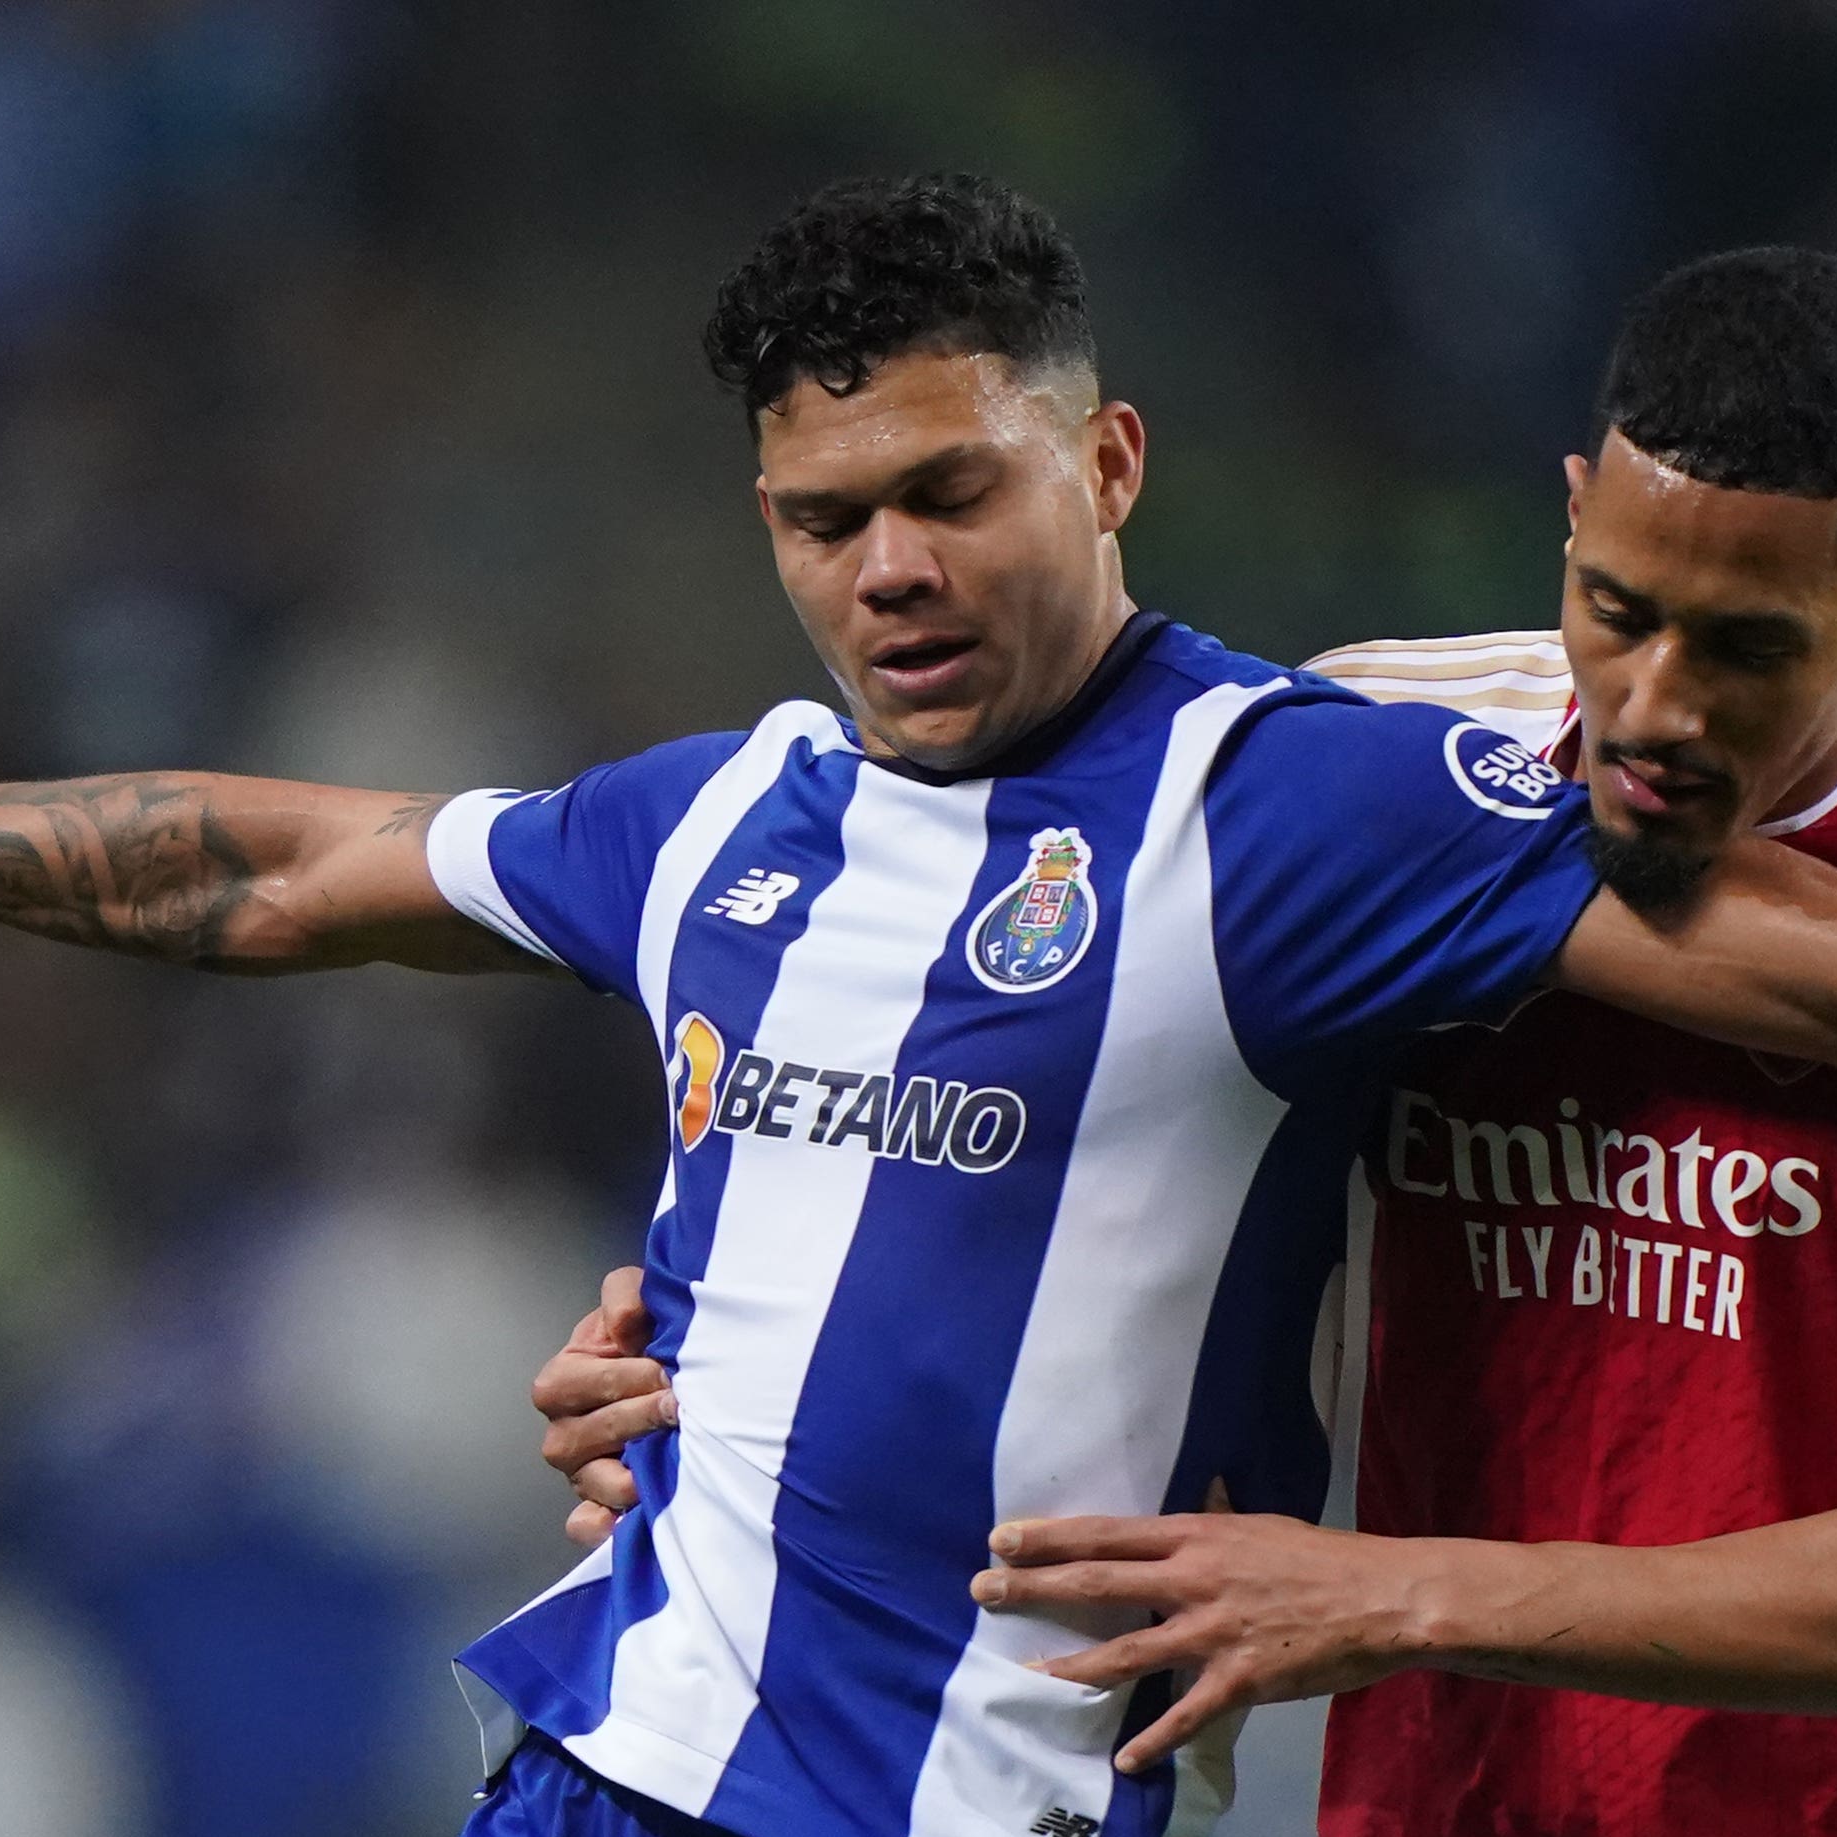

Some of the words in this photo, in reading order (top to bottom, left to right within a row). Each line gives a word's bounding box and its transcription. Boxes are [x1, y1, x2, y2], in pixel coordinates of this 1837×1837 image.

[1507, 761, 1562, 801] BO
[715, 1049, 1026, 1173] BETANO
[1386, 1088, 1823, 1238] Emirates
[1464, 1220, 1555, 1300] FLY
